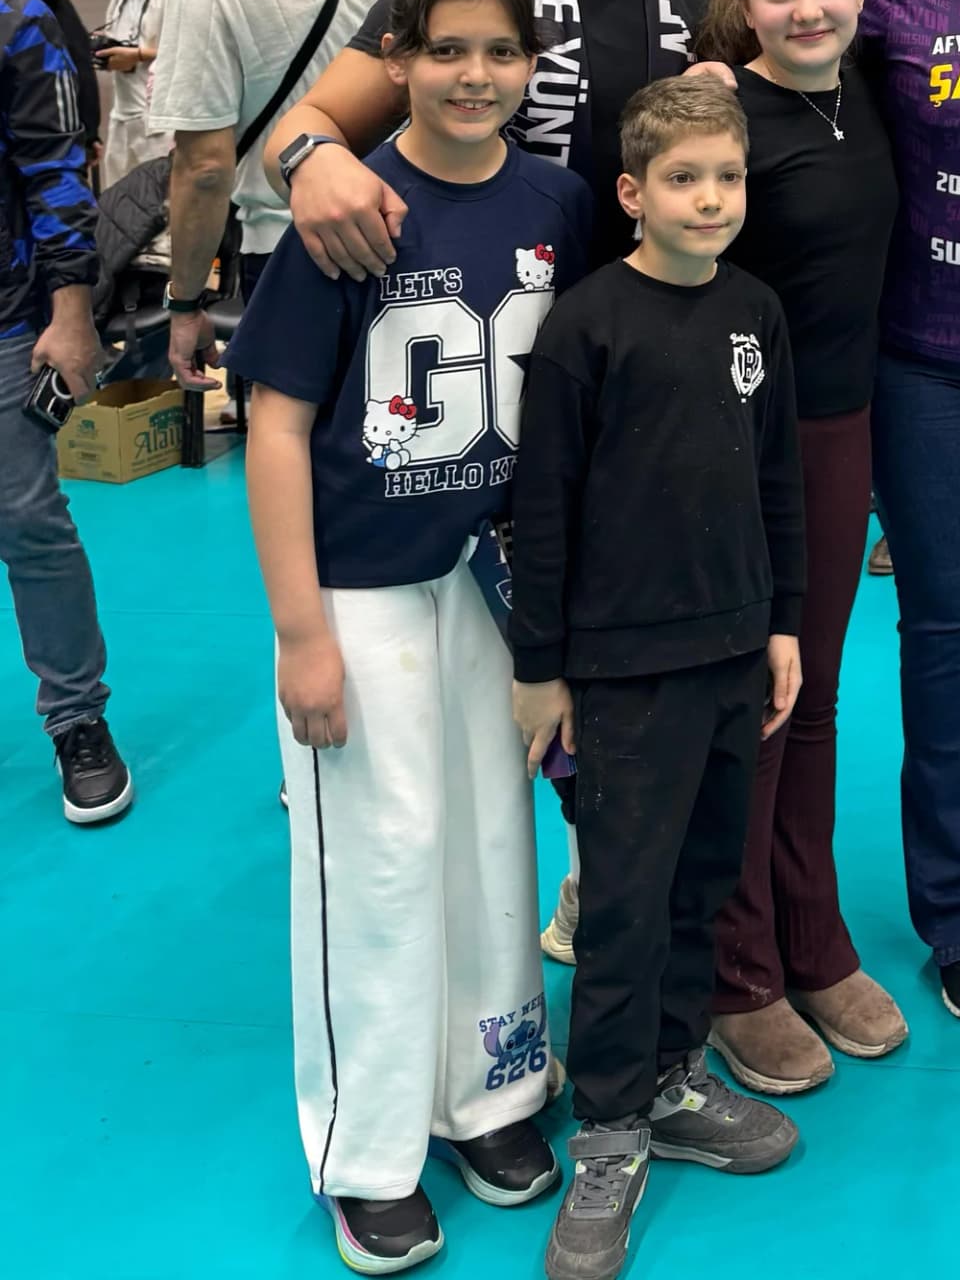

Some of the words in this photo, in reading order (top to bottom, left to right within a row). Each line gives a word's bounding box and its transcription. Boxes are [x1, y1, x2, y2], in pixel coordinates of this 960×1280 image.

[380, 267, 463, 301] LET'S
[385, 463, 484, 498] HELLO
[489, 455, 517, 486] KI
[479, 1011, 516, 1033] STAY
[485, 1041, 548, 1091] 626
